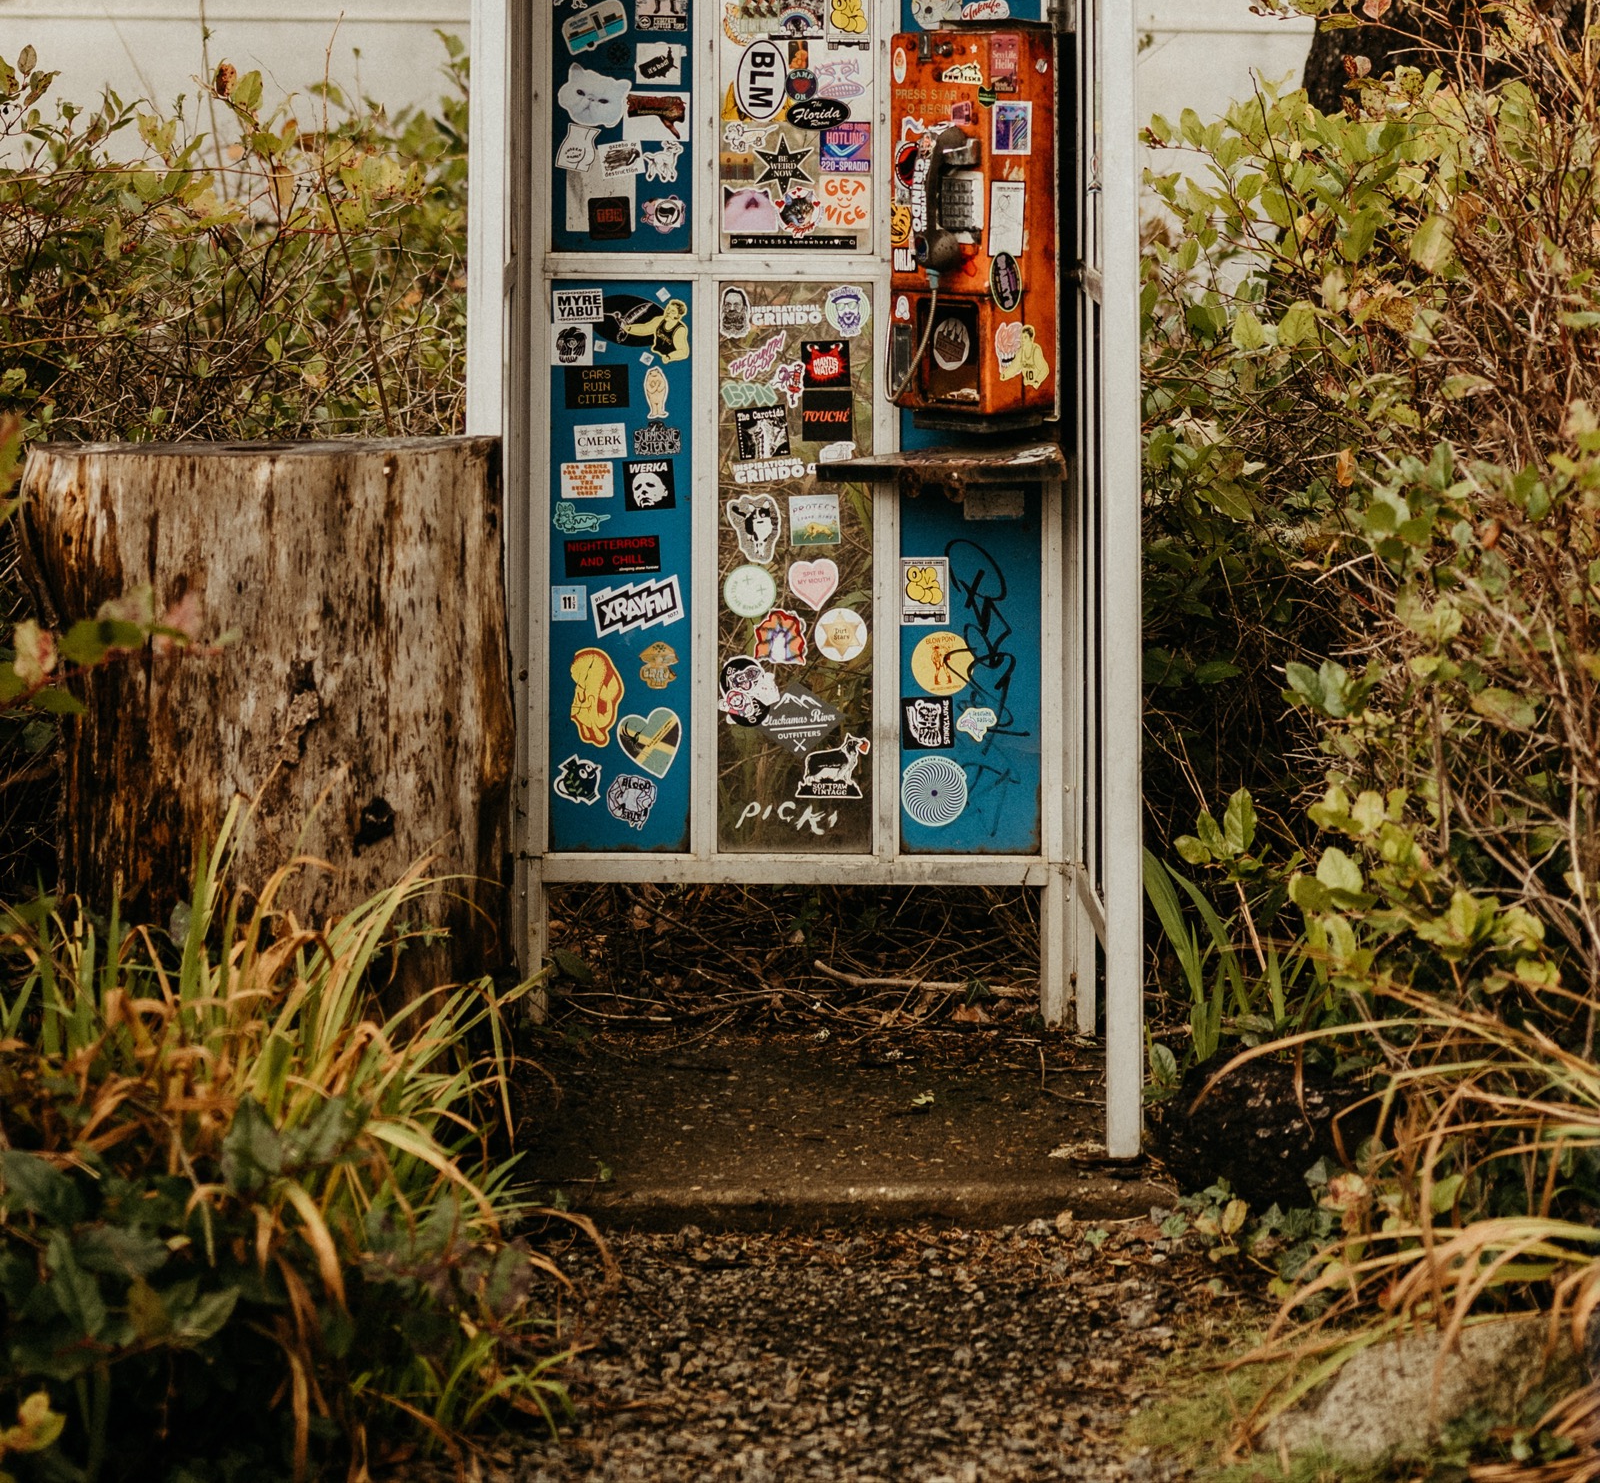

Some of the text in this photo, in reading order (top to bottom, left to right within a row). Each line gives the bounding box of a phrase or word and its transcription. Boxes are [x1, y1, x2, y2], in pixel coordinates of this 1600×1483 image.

[748, 51, 776, 109] BLM
[789, 72, 814, 81] CAMP
[895, 88, 927, 99] PRESS
[811, 100, 823, 108] The
[920, 103, 951, 115] BEGIN
[792, 107, 842, 124] Florida
[826, 131, 865, 145] HOTLINE
[609, 143, 629, 151] gazebo
[769, 161, 797, 170] WEIRD
[821, 161, 869, 172] 220-SPRADIO
[605, 167, 639, 178] destruction
[824, 178, 866, 197] GET
[911, 158, 925, 232] GRINDO
[557, 294, 602, 306] MYRE
[558, 305, 602, 318] YABUT
[751, 304, 821, 313] INSPIRATIONAL
[751, 311, 822, 326] GRINDO
[730, 335, 785, 374] THE COUNTRY
[813, 356, 839, 368] MANTIS
[581, 369, 612, 380] CARS
[813, 364, 839, 376] WATCH
[583, 382, 611, 392] RUIN
[577, 393, 617, 405] CITIES
[737, 412, 750, 421] The
[802, 407, 851, 423] TOUCHÉ
[577, 435, 622, 447] CMERK
[628, 462, 668, 474] WERKA
[732, 458, 804, 472] INSPIRATIONAL
[734, 464, 805, 484] GRINDO
[567, 537, 656, 553] NIGHTTERRORS
[580, 554, 645, 567] AND CHILL
[808, 577, 831, 585] MOUTH
[562, 596, 572, 610] 11
[600, 586, 674, 626] XRAYFM
[810, 708, 836, 723] River
[777, 729, 822, 740] OUTFITTERS
